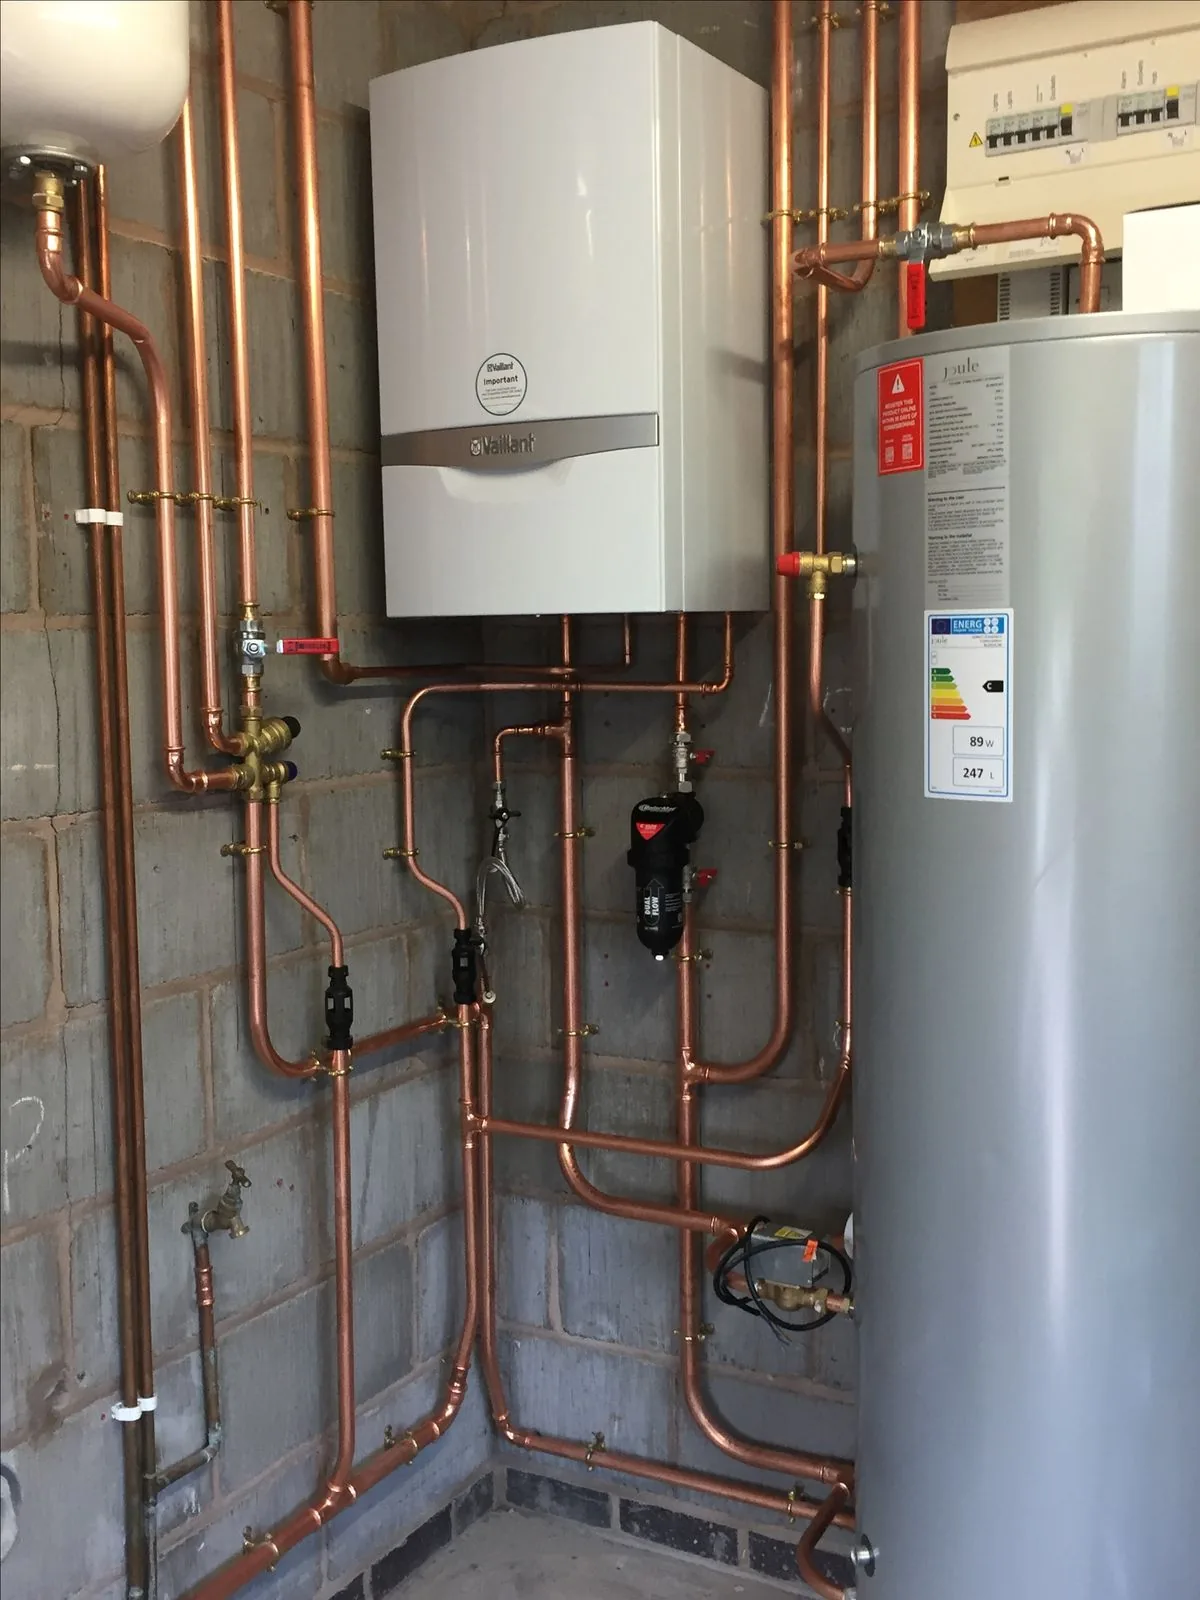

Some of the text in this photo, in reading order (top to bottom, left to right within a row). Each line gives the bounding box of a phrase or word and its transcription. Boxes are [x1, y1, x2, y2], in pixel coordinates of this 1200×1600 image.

[483, 374, 518, 386] Important
[481, 432, 536, 455] Vaillant
[953, 620, 982, 629] ENERG
[970, 736, 984, 747] 89
[963, 768, 983, 778] 247
